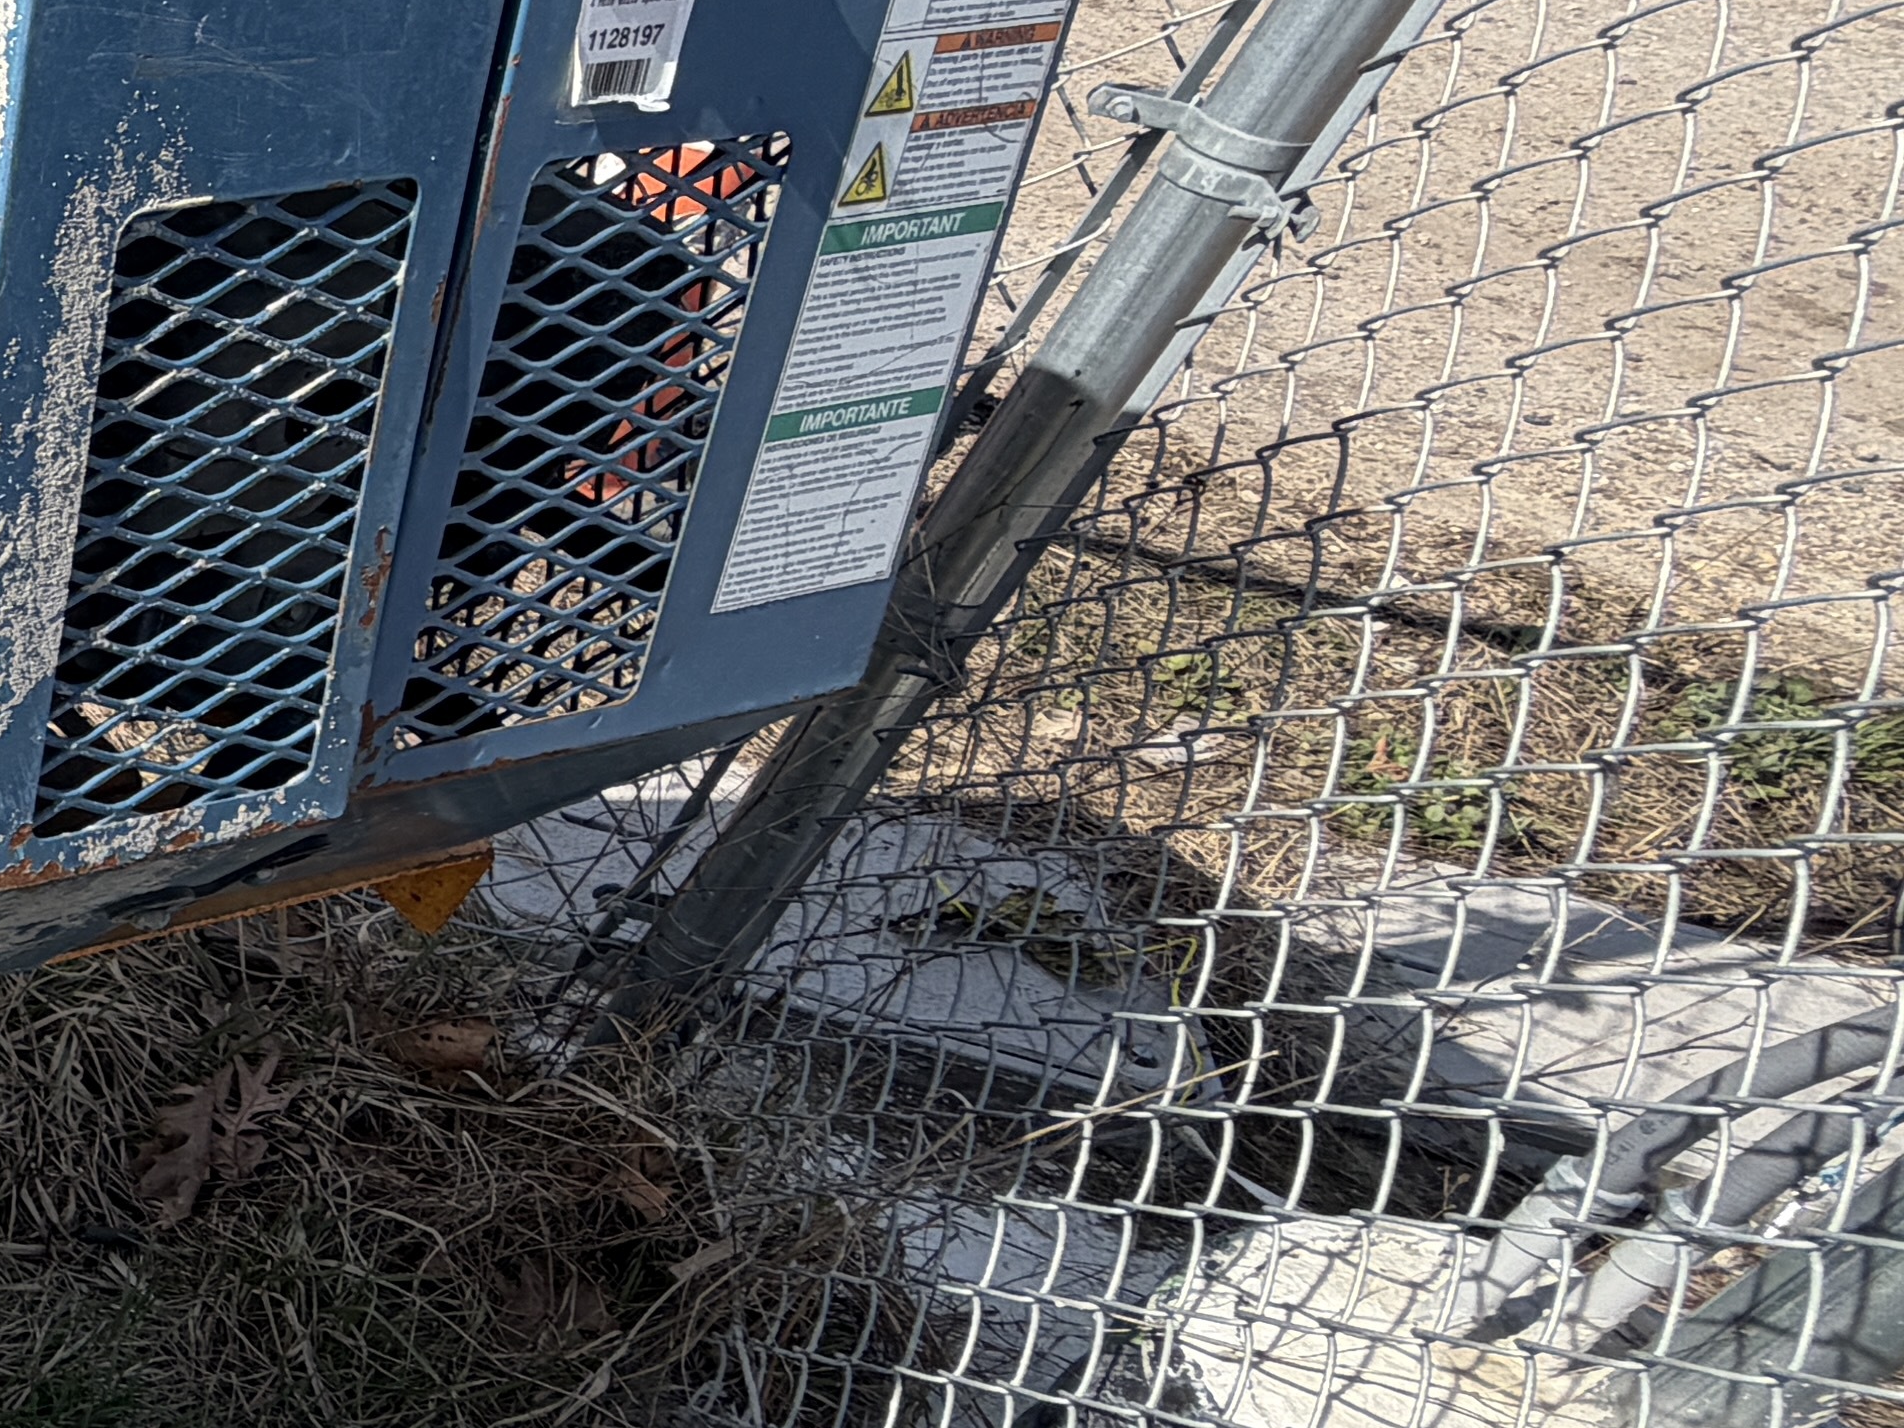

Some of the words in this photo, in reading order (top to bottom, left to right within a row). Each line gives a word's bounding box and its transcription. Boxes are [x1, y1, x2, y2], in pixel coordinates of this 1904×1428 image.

[588, 24, 665, 51] 1128197
[974, 26, 1035, 48] WARNING
[861, 212, 967, 246] IMPORTANT
[799, 397, 913, 433] IMPORTANTE
